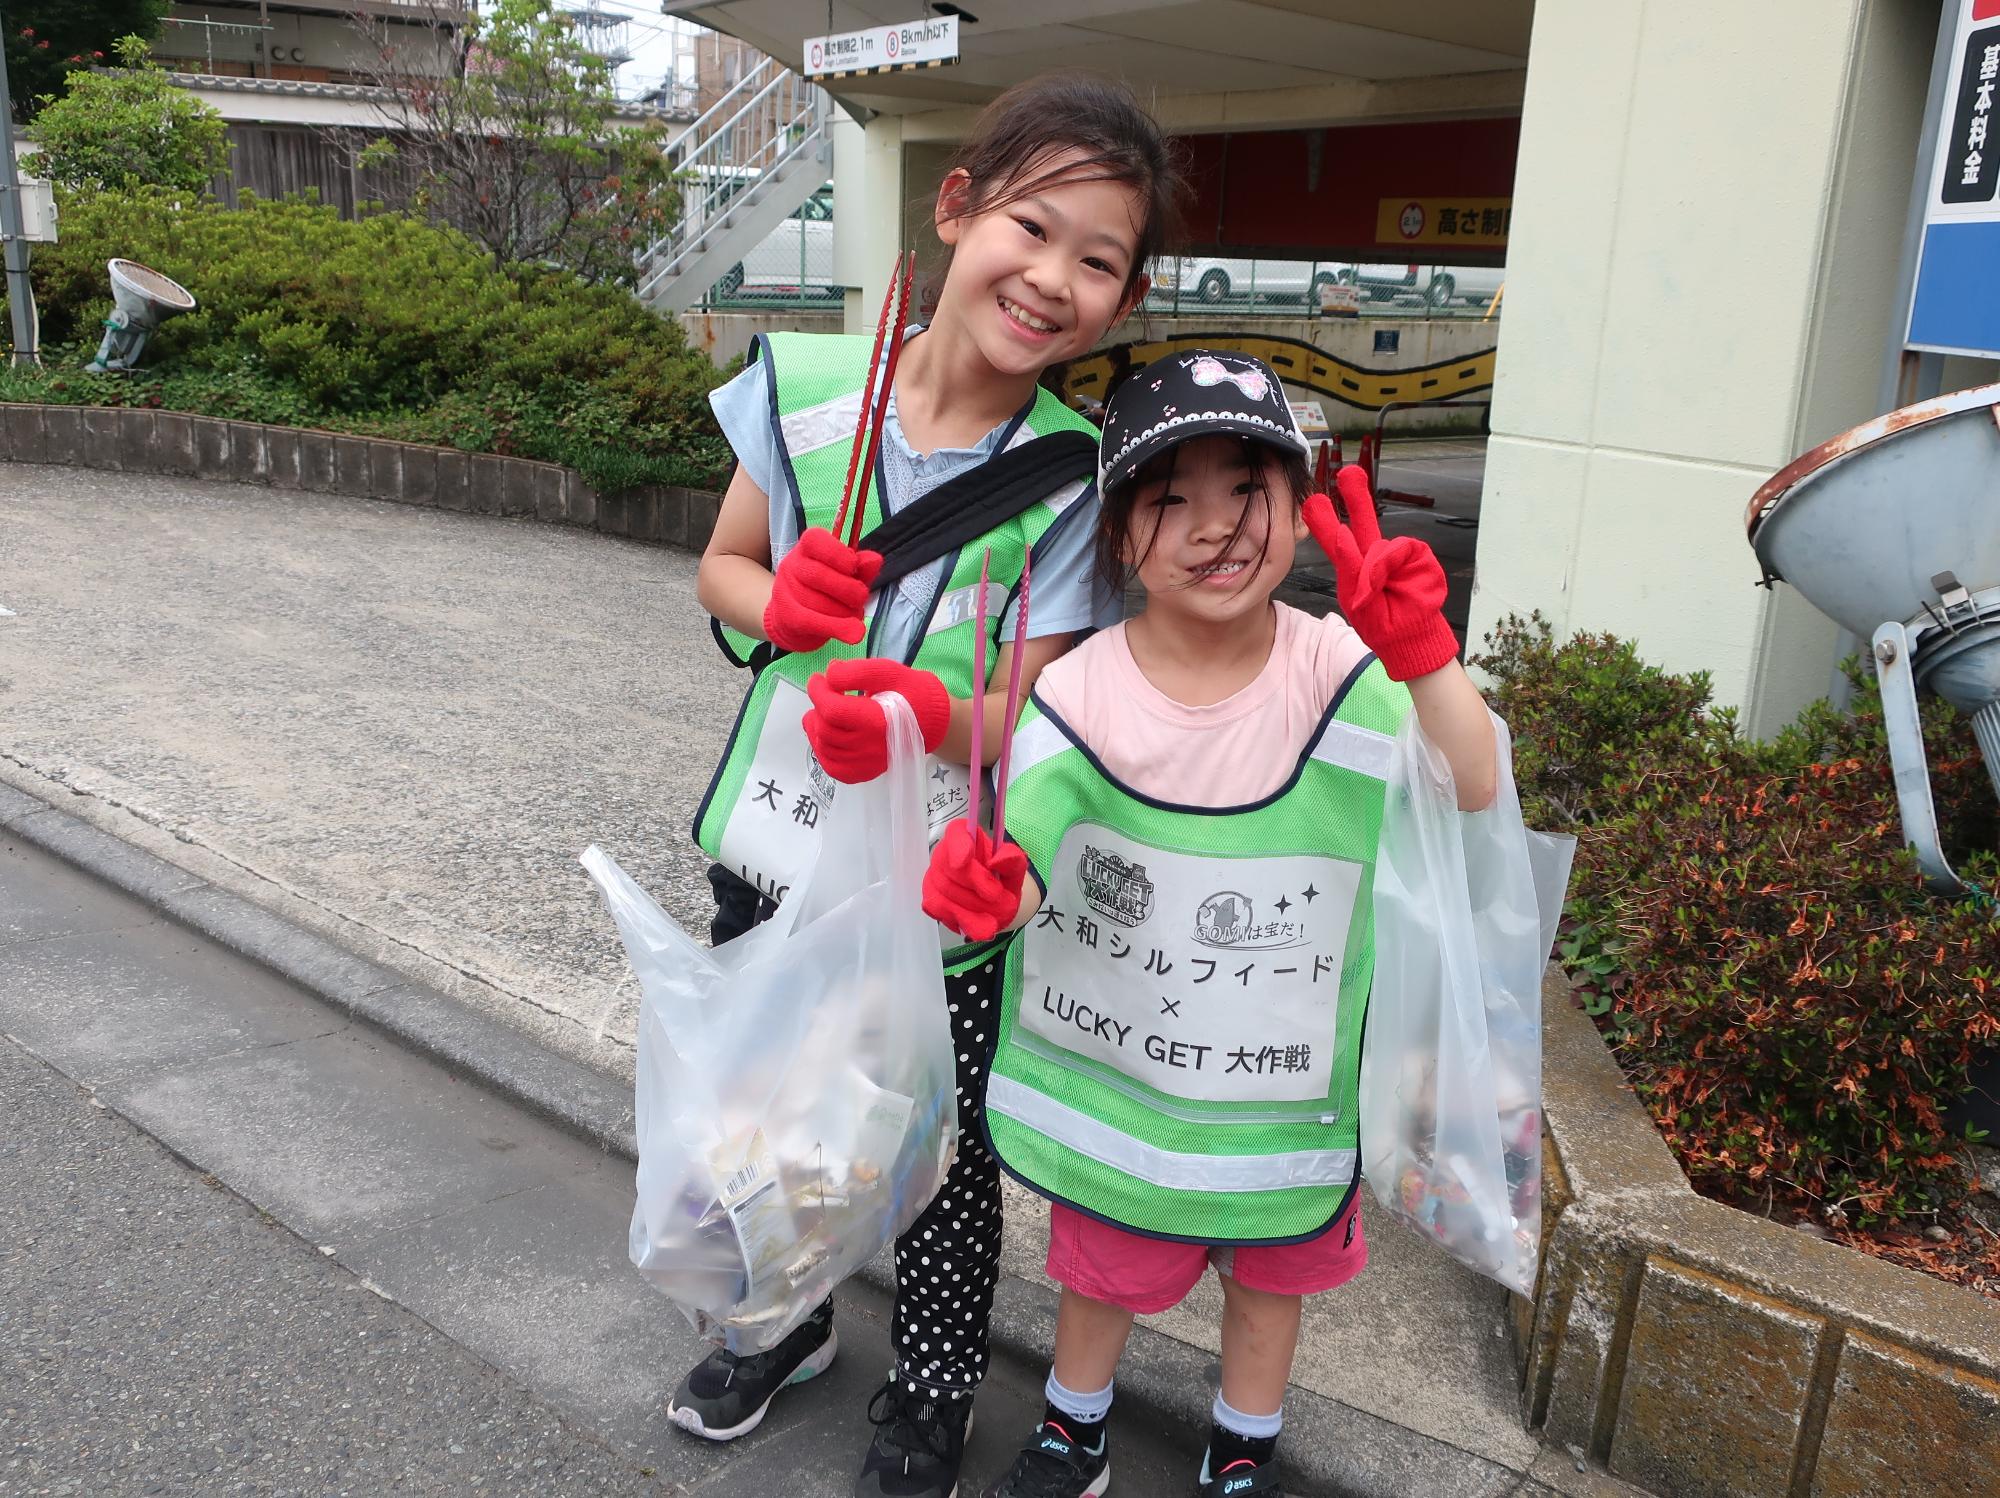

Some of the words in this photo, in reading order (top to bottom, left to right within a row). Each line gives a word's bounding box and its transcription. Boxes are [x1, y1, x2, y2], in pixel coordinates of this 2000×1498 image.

[824, 37, 874, 57] 高さ制限2.1m
[890, 37, 896, 51] 8
[901, 23, 949, 45] 8km/h以下
[1961, 43, 2000, 185] 基本料金
[1438, 208, 1511, 236] 高さ制
[927, 784, 970, 817] は宝だ
[1082, 855, 1121, 888] LUCKY
[1121, 878, 1153, 905] GET
[1037, 904, 1334, 987] 大和シルフィード
[1043, 986, 1133, 1047] LUCKY
[1144, 1035, 1212, 1071] GET
[1225, 1044, 1311, 1075] 大作戦
[1050, 1441, 1069, 1454] asics
[1234, 1478, 1253, 1490] asics
